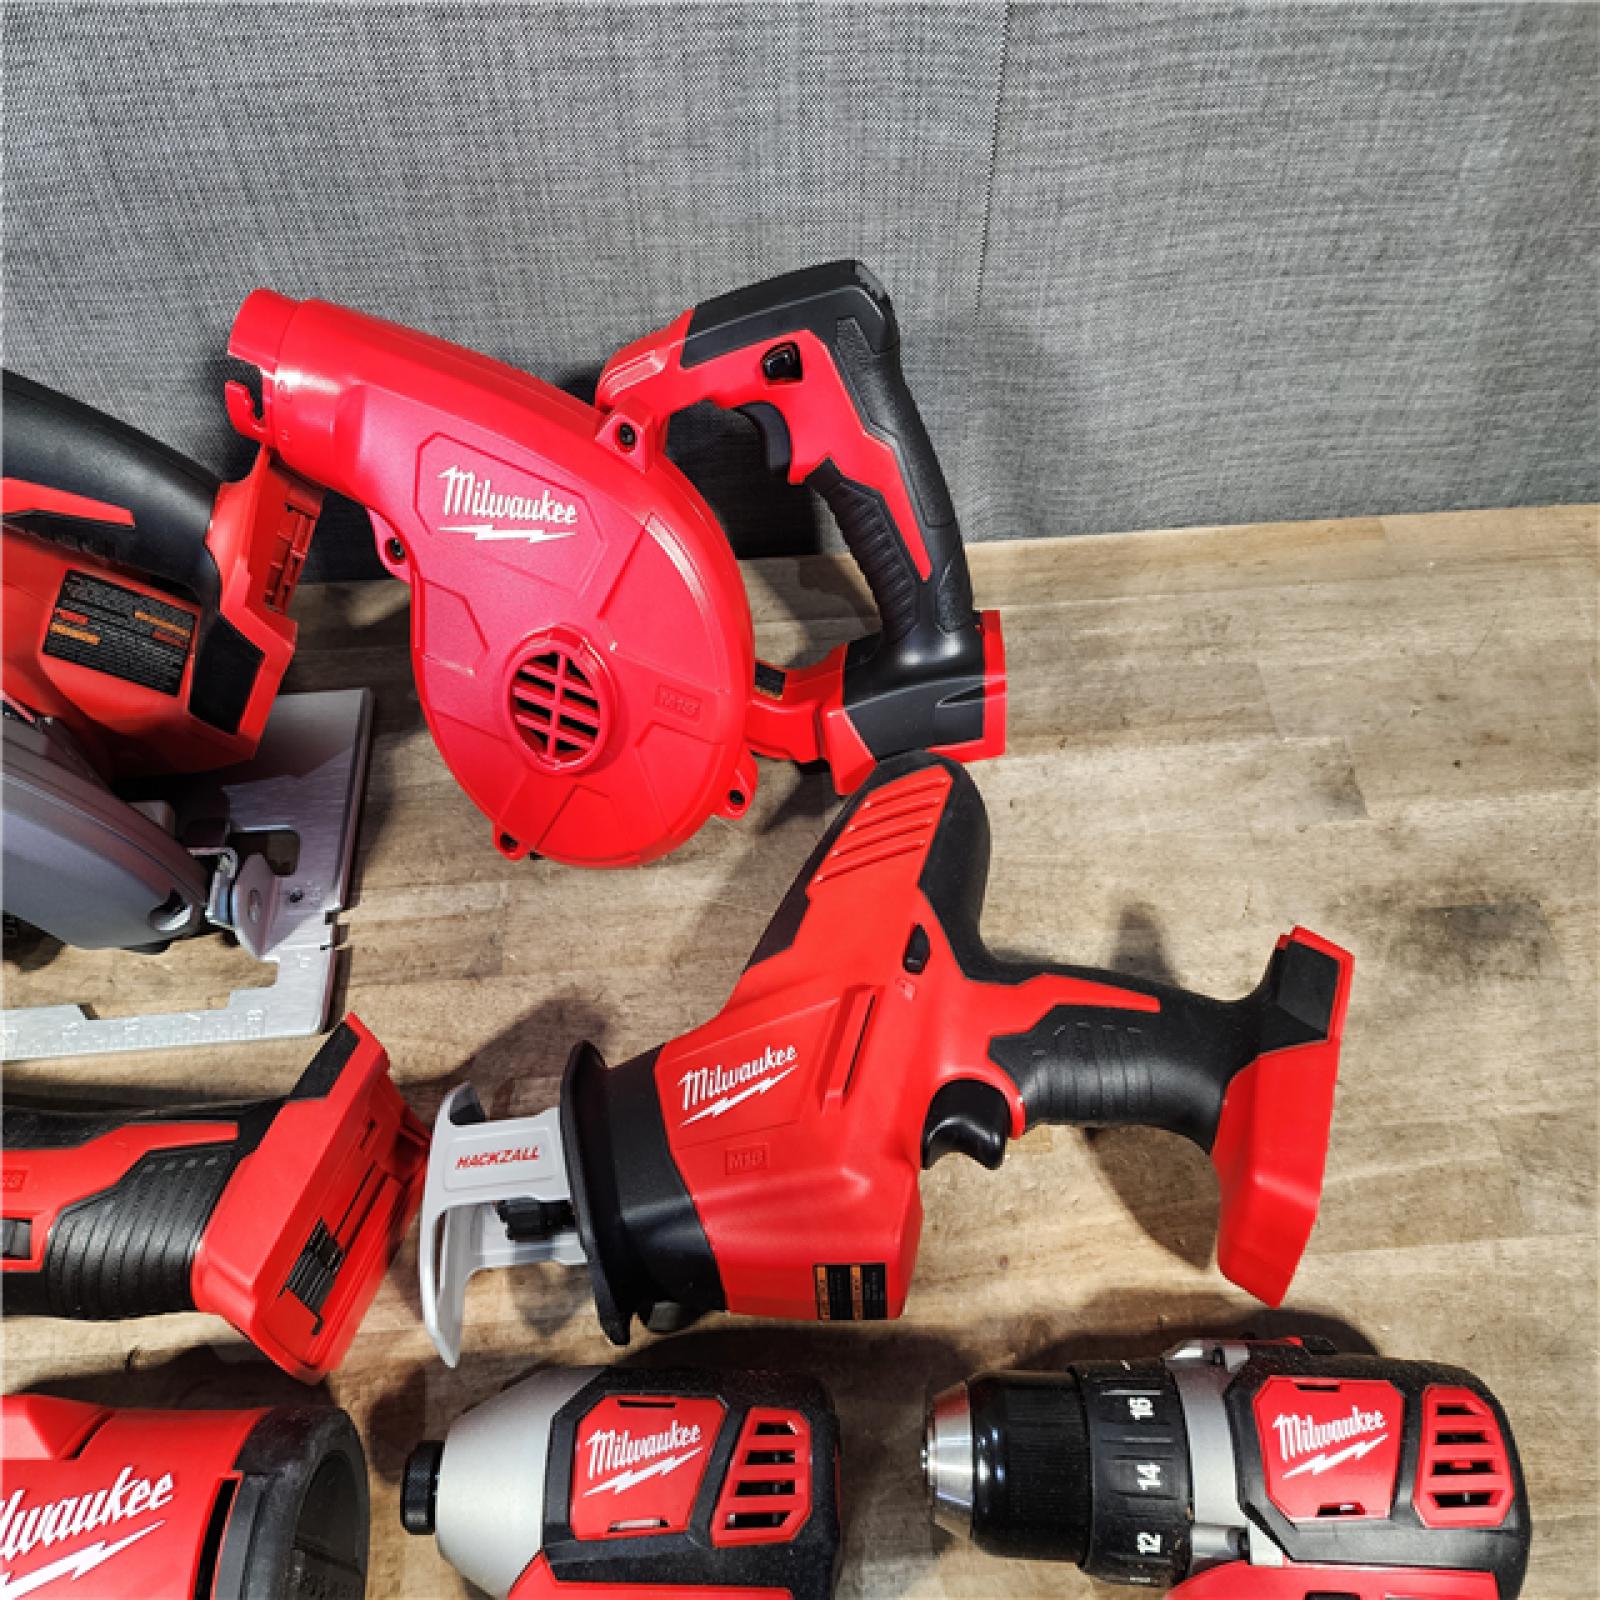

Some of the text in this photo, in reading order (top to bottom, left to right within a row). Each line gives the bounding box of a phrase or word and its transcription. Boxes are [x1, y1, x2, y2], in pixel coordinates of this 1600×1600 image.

[438, 465, 577, 525] Milwaukee
[678, 1044, 798, 1110] Milwaukee
[455, 1145, 540, 1169] HACKZALL
[585, 1419, 701, 1480] Milwaukee
[1272, 1404, 1387, 1462] Milwaukee
[1136, 1463, 1162, 1491] 14
[2, 1464, 174, 1561] lwaukee
[1136, 1532, 1162, 1555] 12
